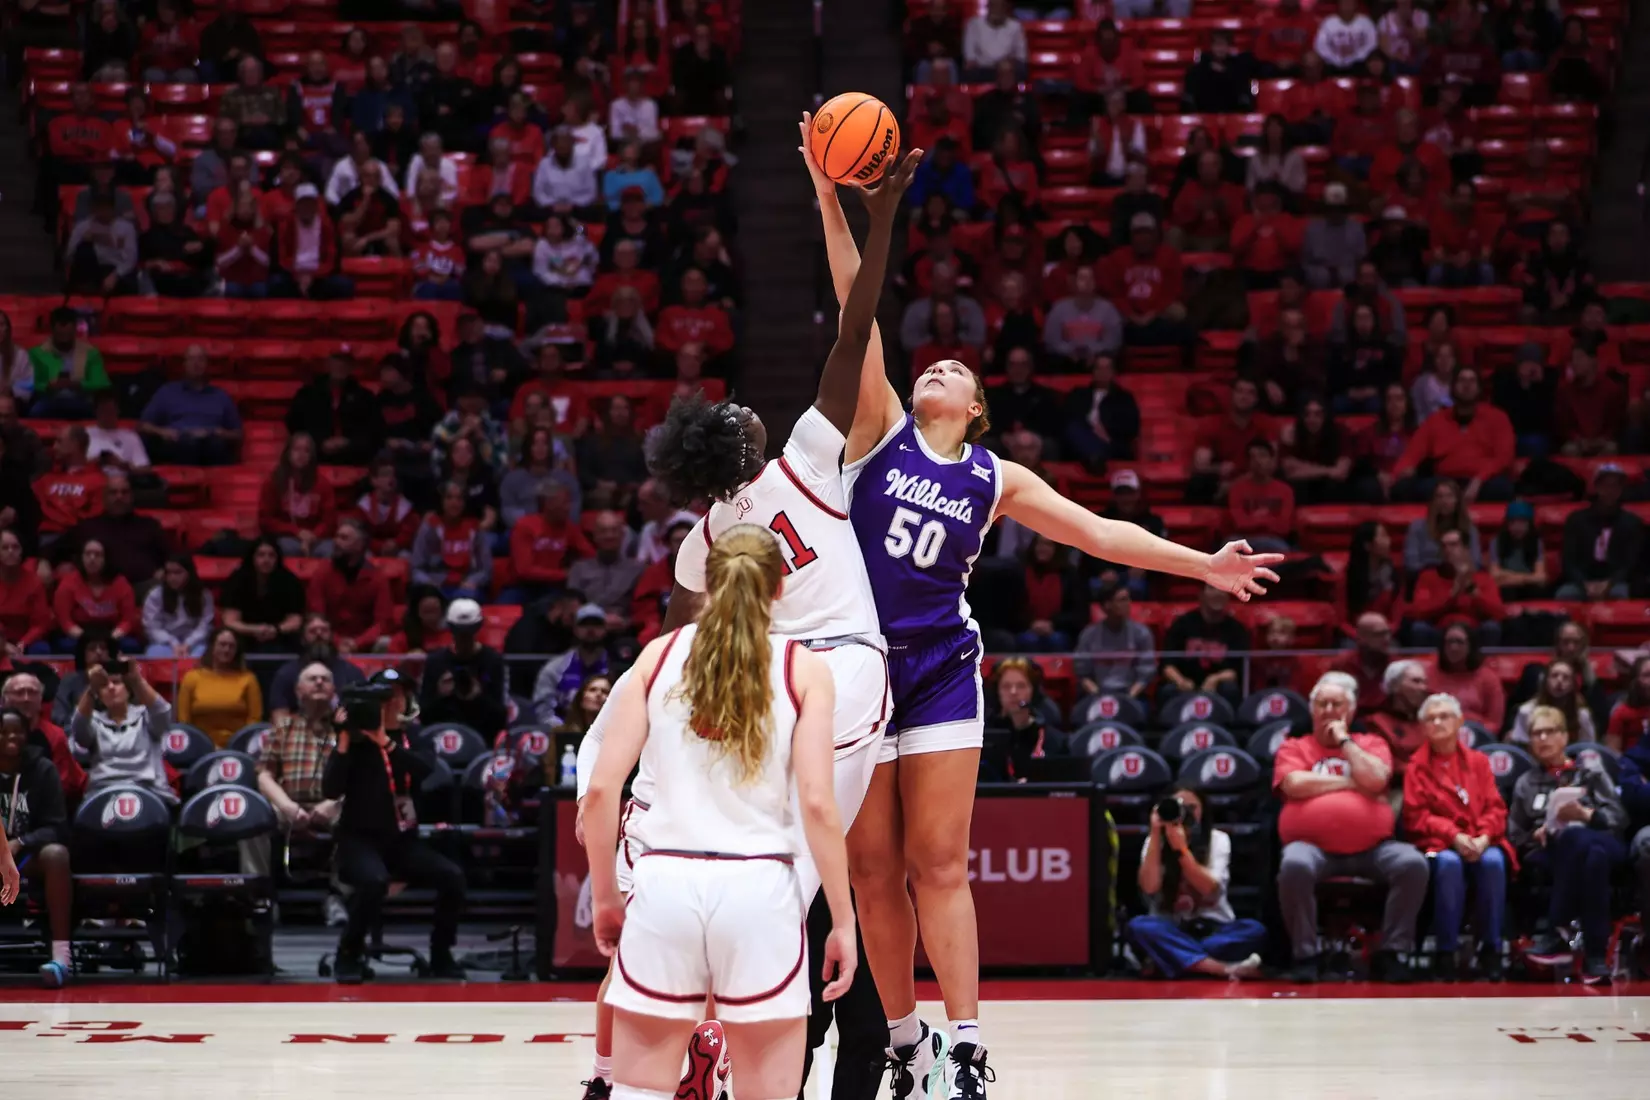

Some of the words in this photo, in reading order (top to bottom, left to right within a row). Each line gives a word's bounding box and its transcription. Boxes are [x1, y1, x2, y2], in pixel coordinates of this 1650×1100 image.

[853, 128, 893, 180] Wilson
[884, 468, 972, 524] Wildcats
[769, 510, 818, 576] 1
[884, 505, 947, 569] 50
